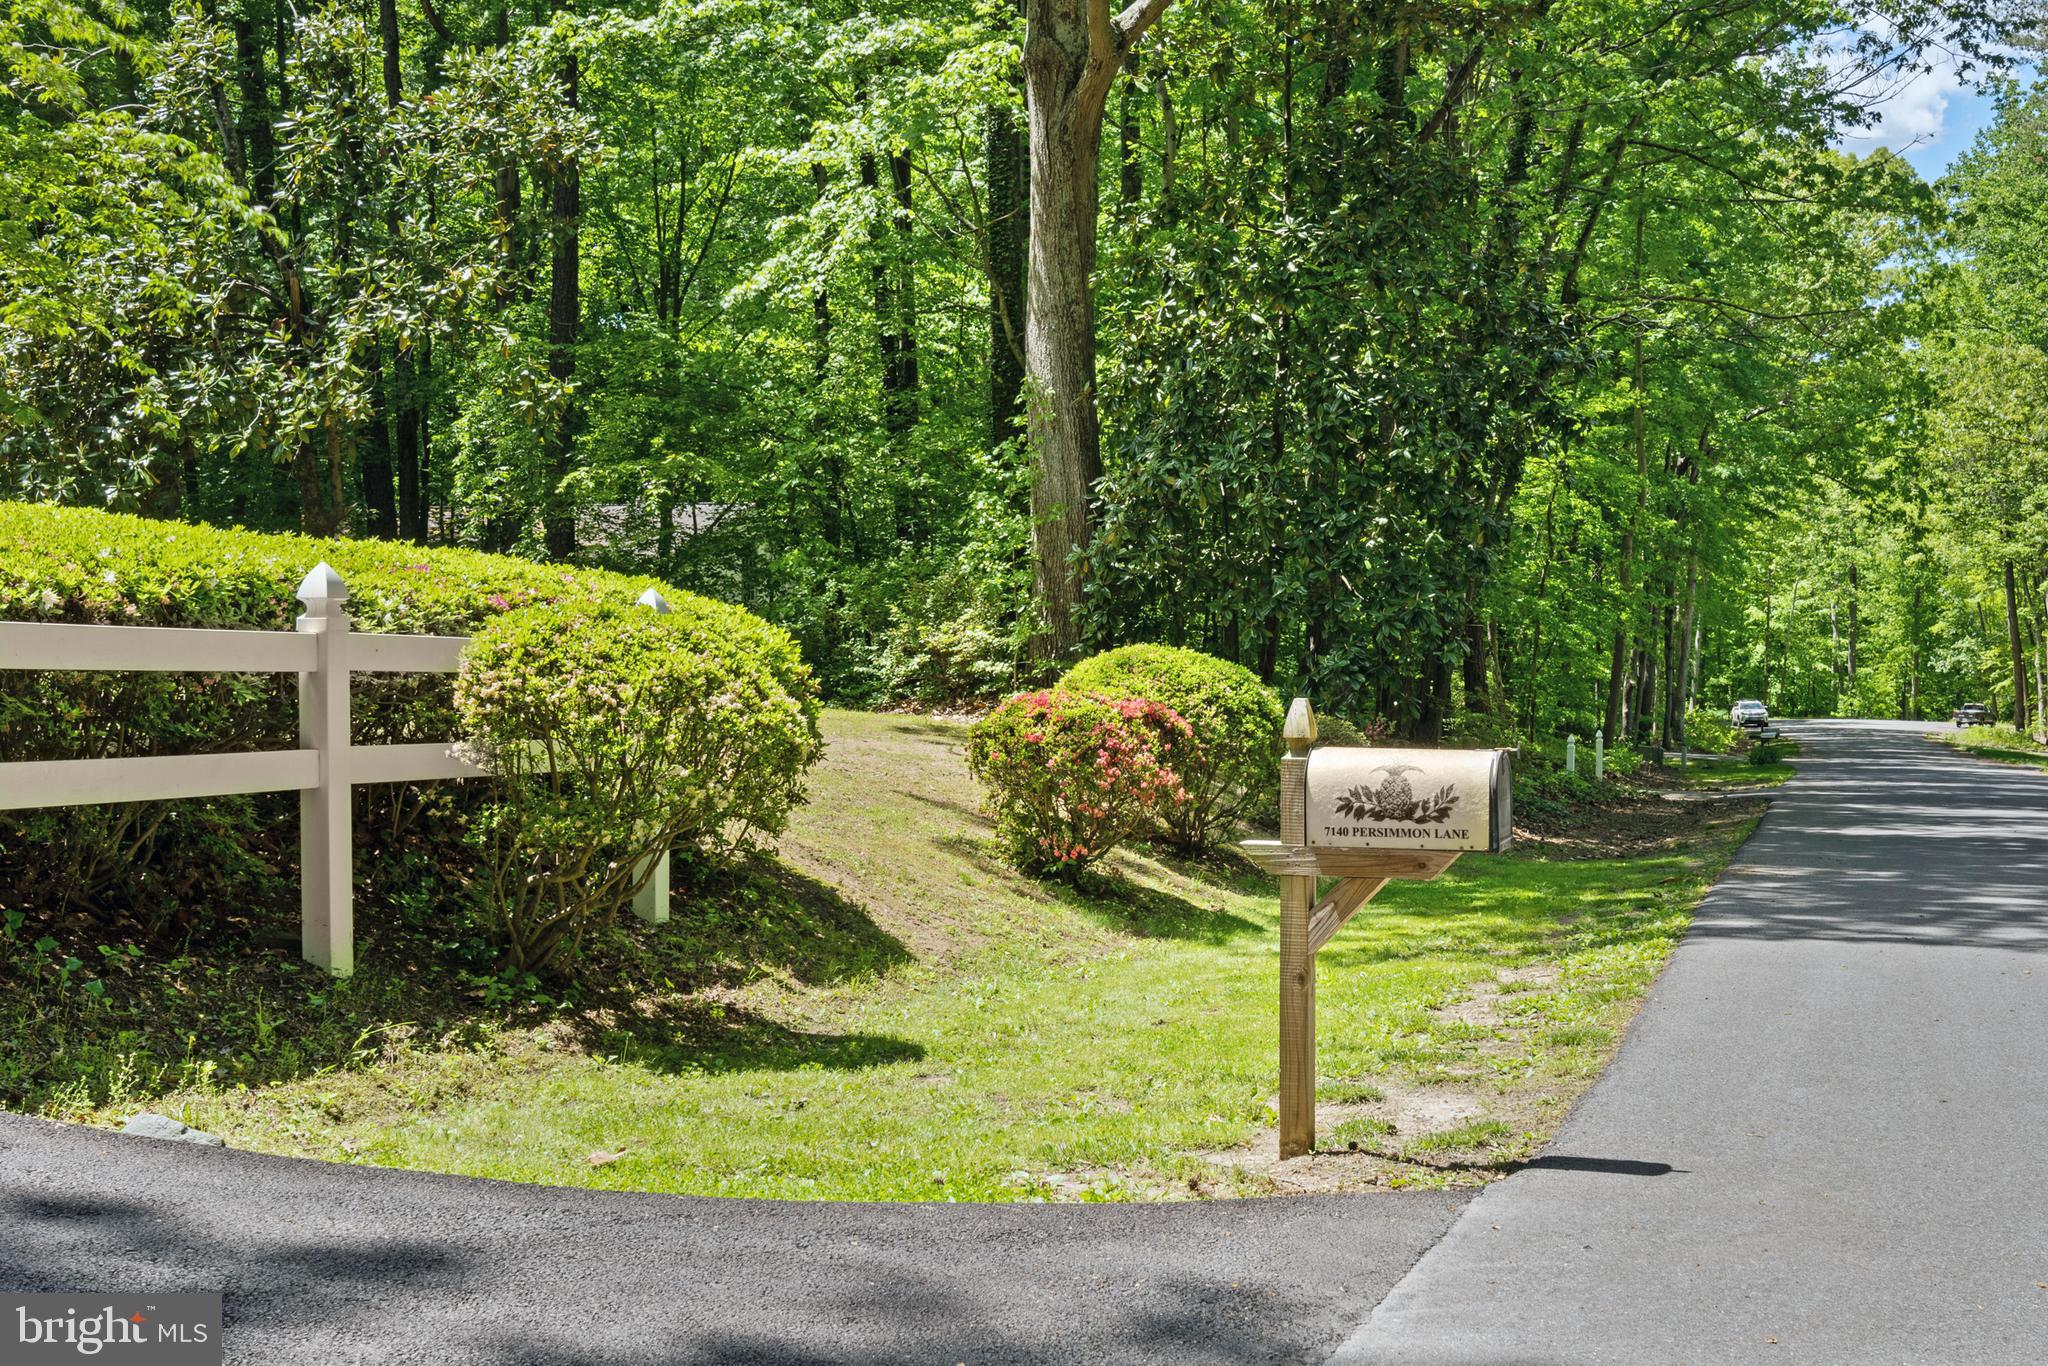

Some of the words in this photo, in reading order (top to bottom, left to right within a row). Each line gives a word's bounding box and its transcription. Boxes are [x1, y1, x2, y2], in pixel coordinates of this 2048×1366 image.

[1324, 826, 1349, 837] 7140
[1352, 827, 1431, 839] PERSIMMON
[1434, 828, 1470, 840] LANE
